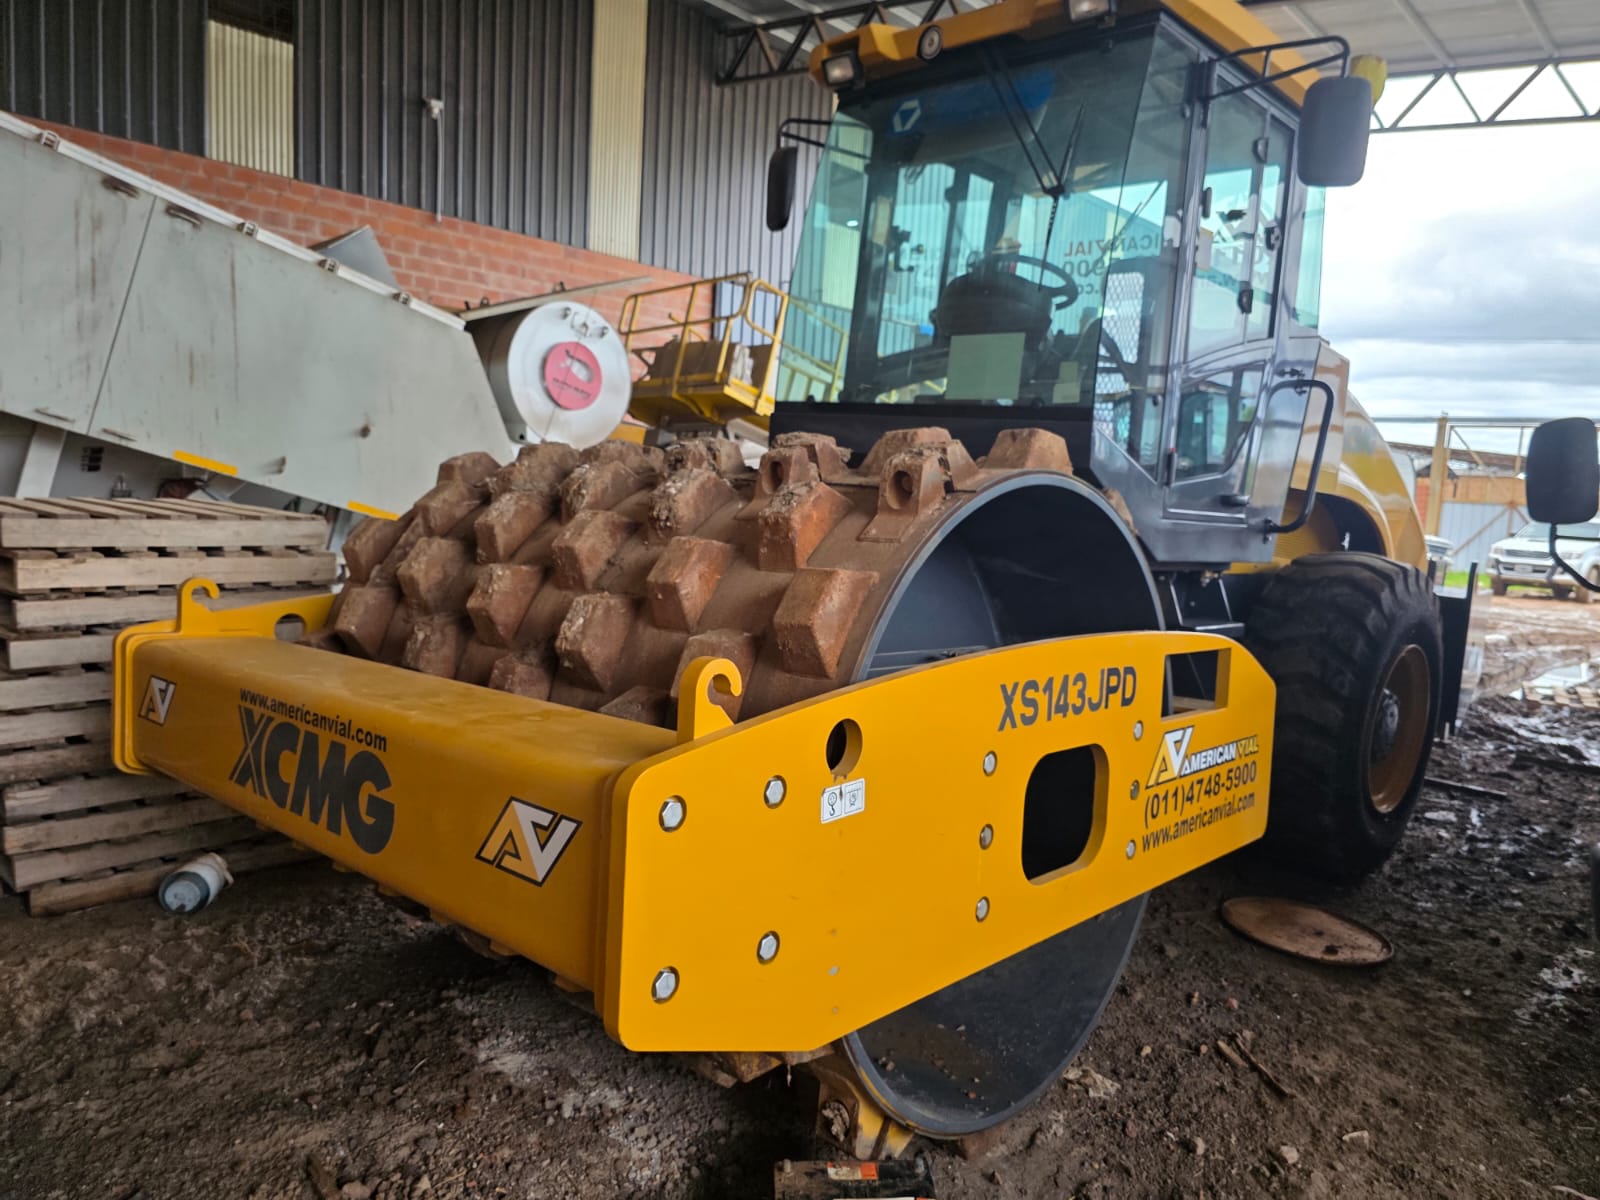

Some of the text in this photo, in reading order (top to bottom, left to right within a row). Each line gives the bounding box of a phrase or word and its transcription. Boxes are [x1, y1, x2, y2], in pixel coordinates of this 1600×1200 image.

[239, 688, 388, 752] www.americanvial.com
[997, 666, 1137, 732] XS143JPD
[229, 704, 395, 854] XCMG
[1142, 791, 1255, 852] www.americanvial.com
